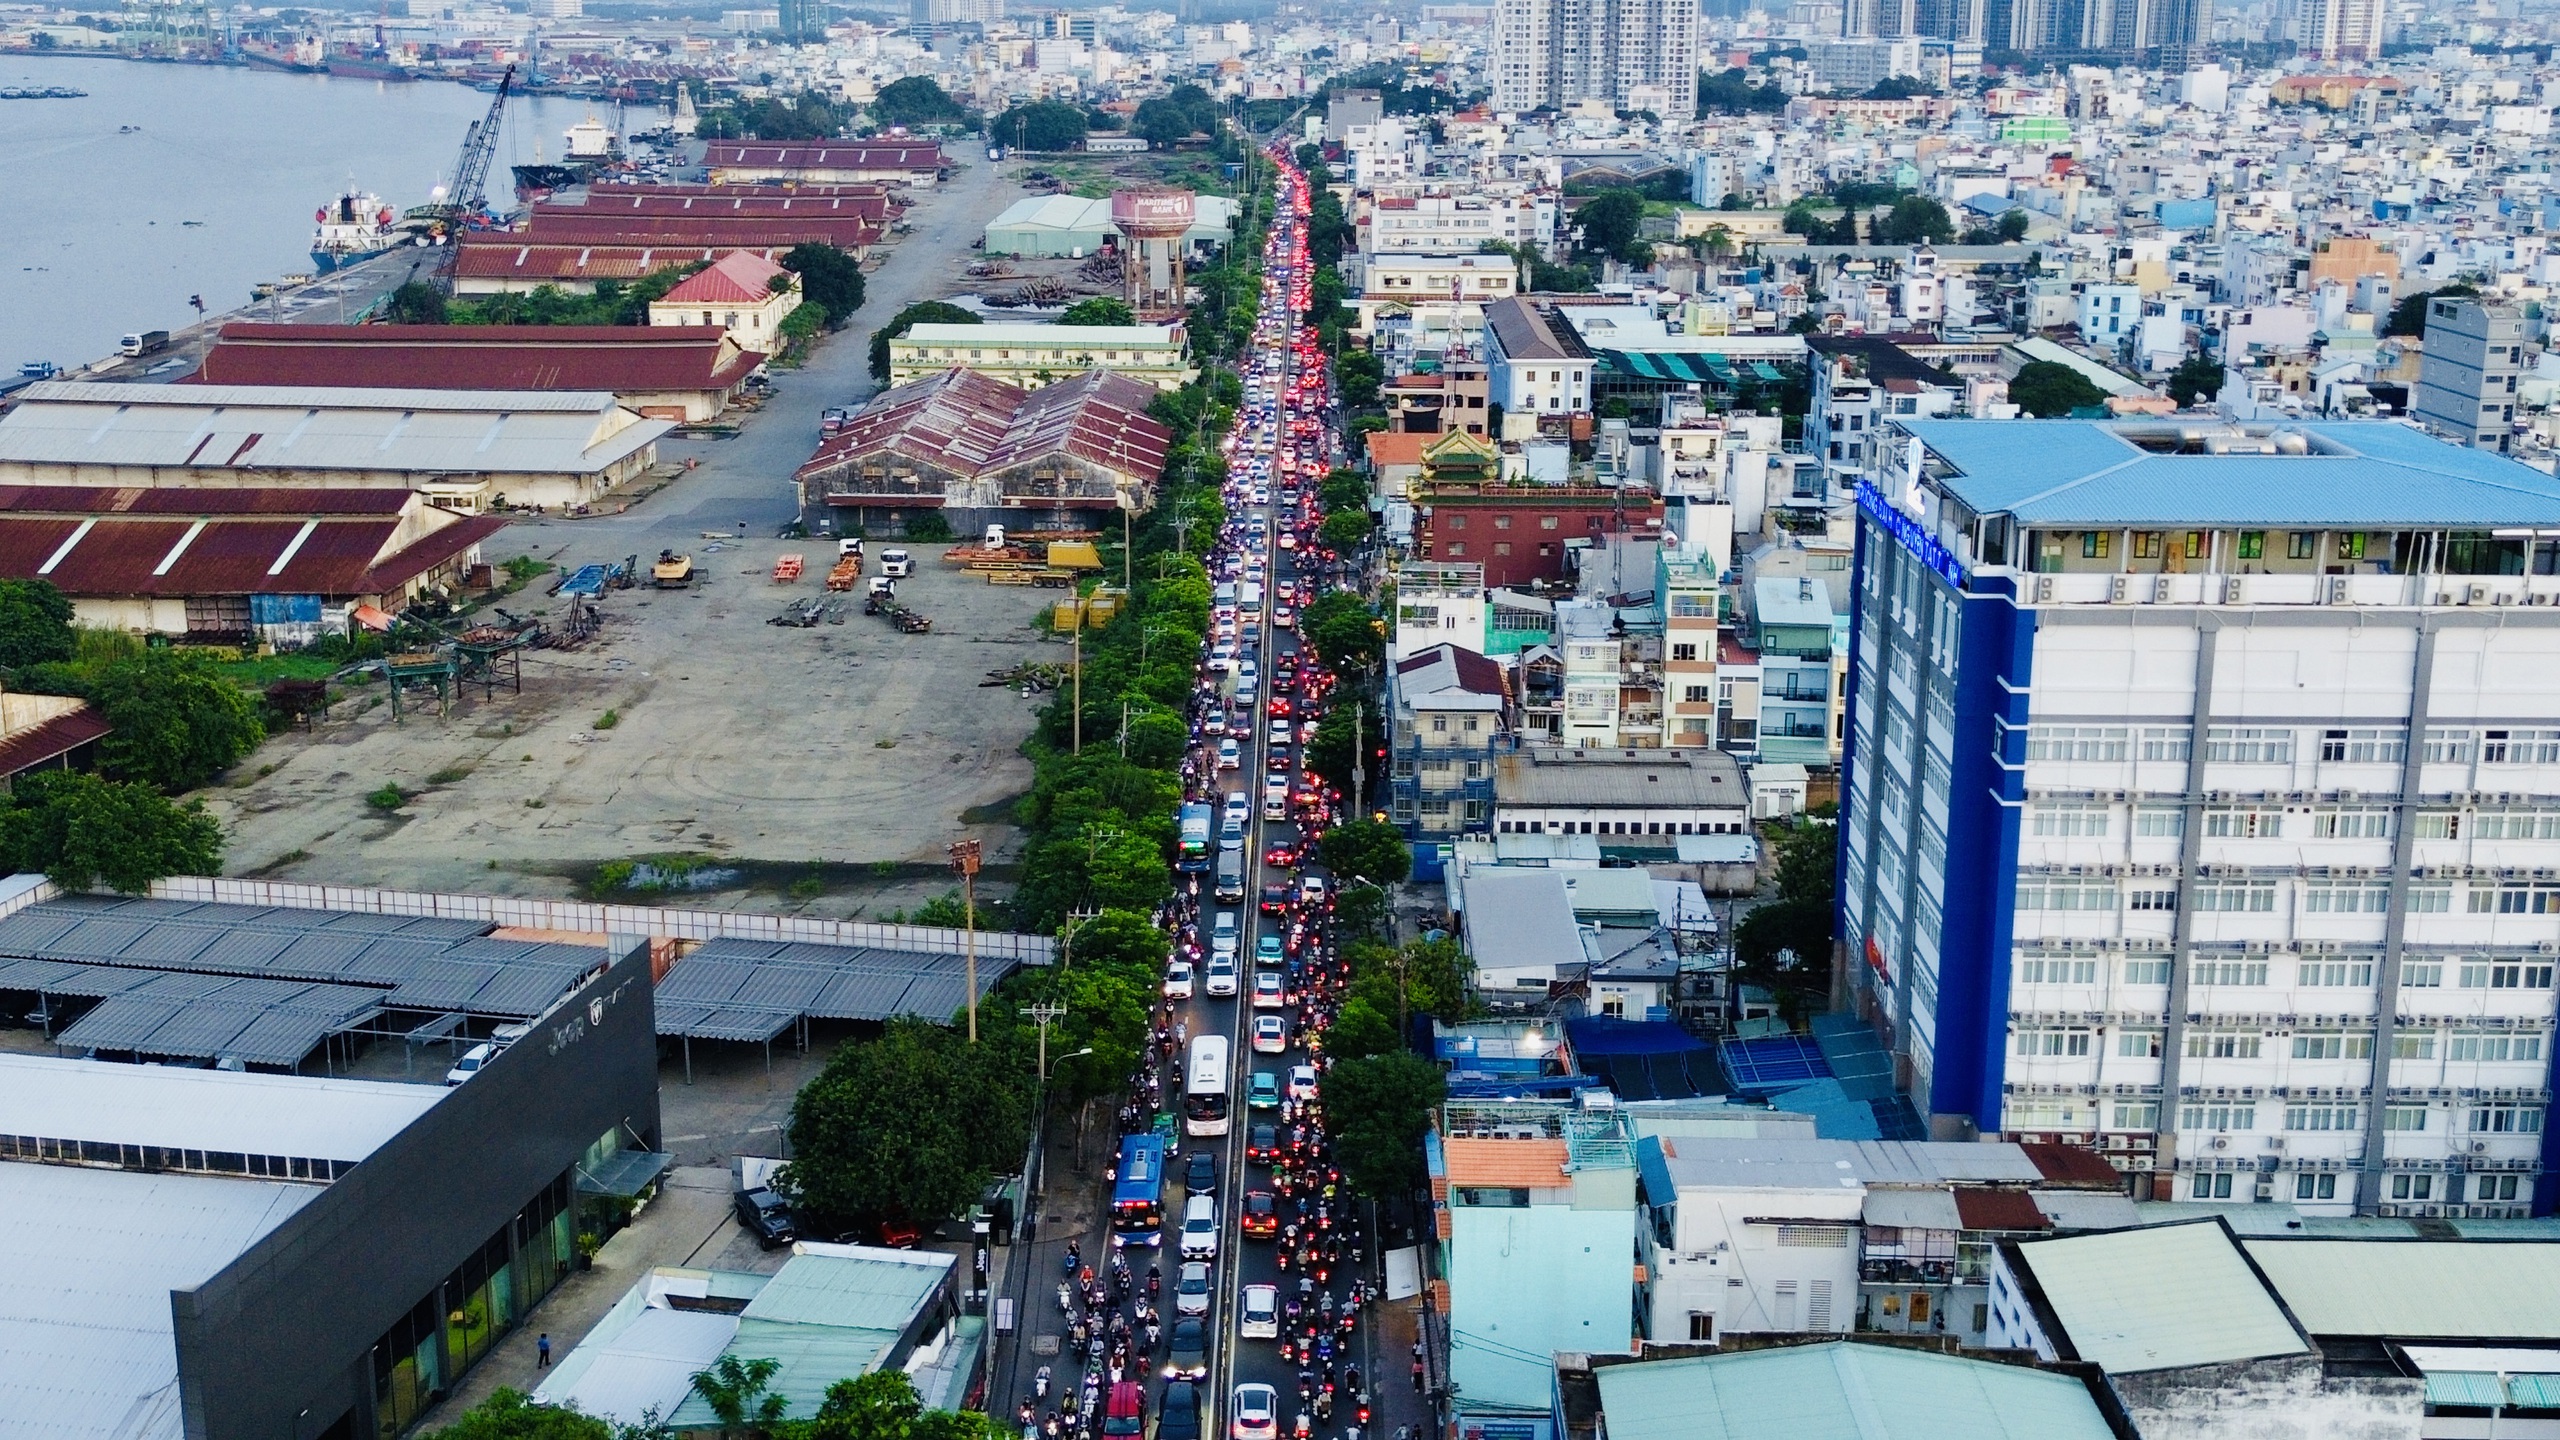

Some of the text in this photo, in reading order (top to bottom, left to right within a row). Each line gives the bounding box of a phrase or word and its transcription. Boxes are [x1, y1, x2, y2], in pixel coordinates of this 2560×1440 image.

[1137, 198, 1174, 206] MARITIME
[1152, 206, 1174, 214] BANK
[975, 1248, 987, 1272] Jeep
